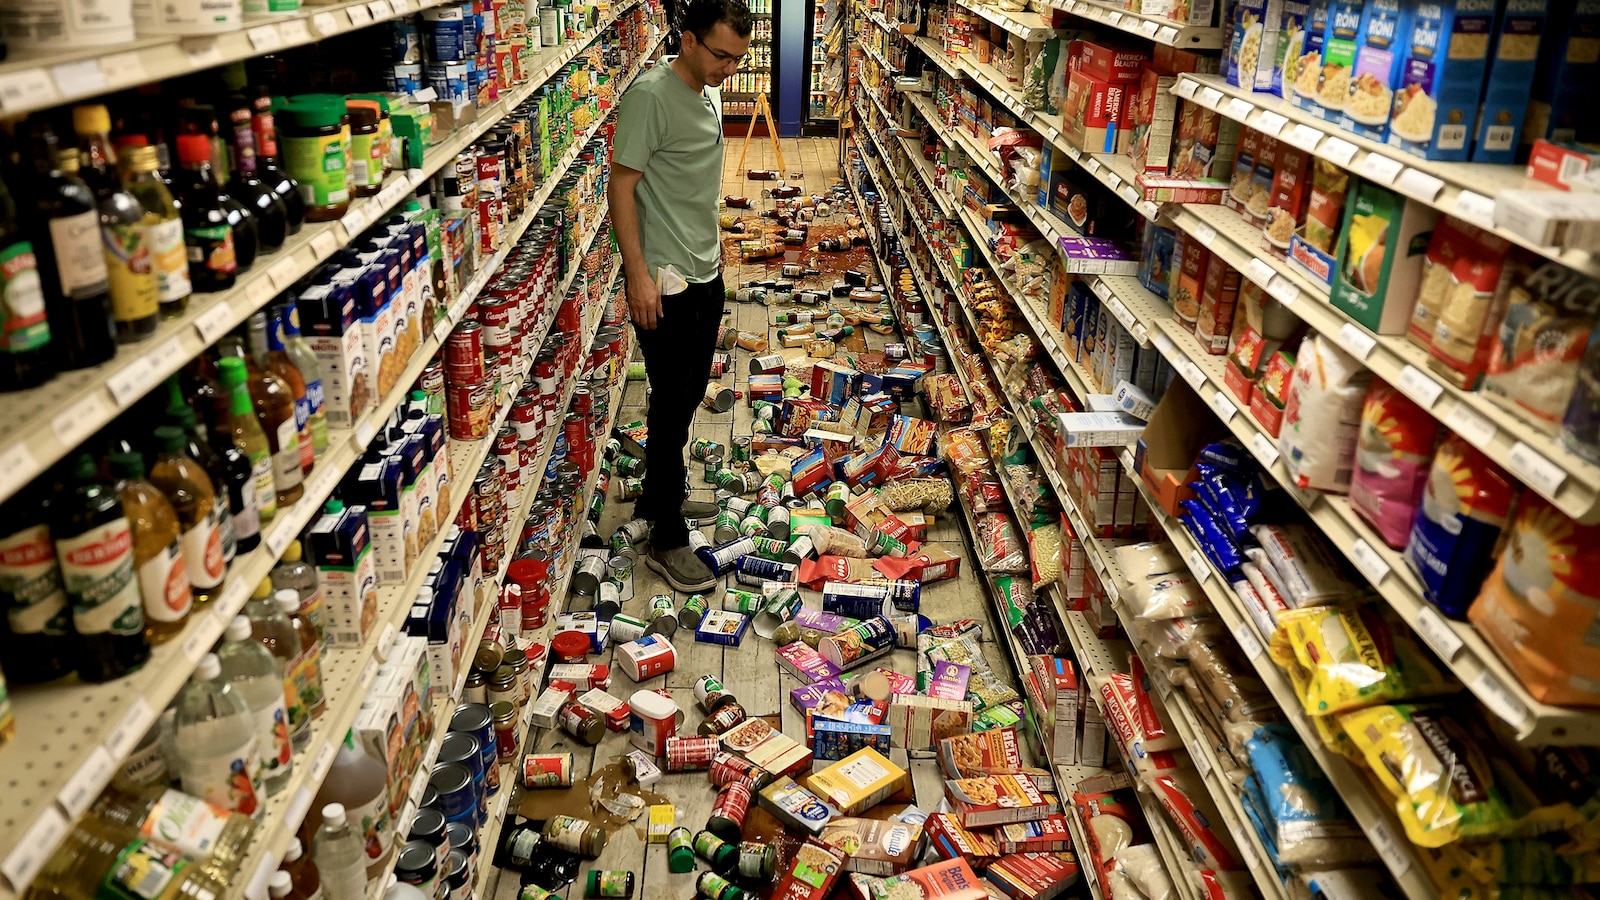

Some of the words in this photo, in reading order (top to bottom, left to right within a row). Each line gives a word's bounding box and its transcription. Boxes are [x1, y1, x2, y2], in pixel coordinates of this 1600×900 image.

[1335, 12, 1360, 30] RONI
[1368, 18, 1395, 38] RONI
[1414, 27, 1438, 48] RONI
[1114, 60, 1139, 68] BEAUTY
[1105, 87, 1116, 113] BEAUTY
[1110, 87, 1123, 122] AMERICAN
[1525, 264, 1600, 314] RIC
[938, 673, 961, 684] Annie's
[1107, 696, 1133, 741] MEXICANO
[996, 733, 1007, 769] Cheeseburge
[1002, 730, 1019, 772] HELPE
[1012, 774, 1043, 804] HELPER
[1453, 764, 1477, 799] RICE
[938, 814, 972, 853] HELPER
[1042, 819, 1054, 834] RONI
[1053, 819, 1066, 834] RICE
[887, 824, 907, 856] Minute
[789, 882, 811, 899] RONI
[938, 870, 958, 893] Original
[947, 866, 970, 892] Ben's
